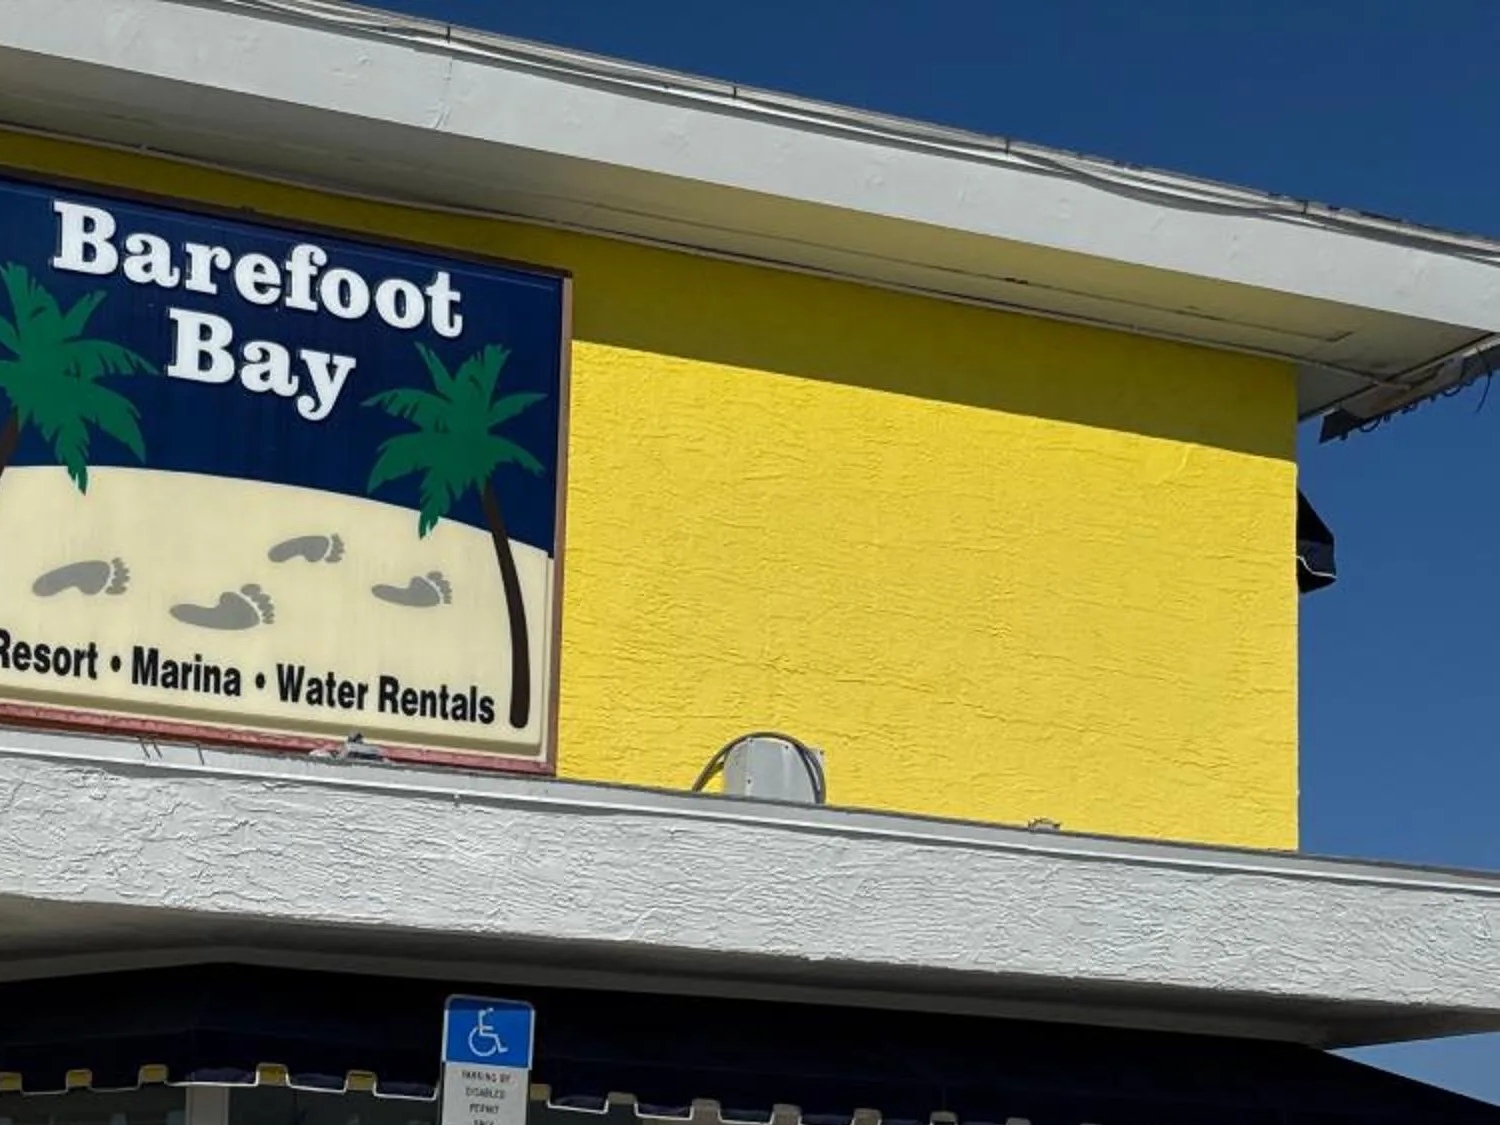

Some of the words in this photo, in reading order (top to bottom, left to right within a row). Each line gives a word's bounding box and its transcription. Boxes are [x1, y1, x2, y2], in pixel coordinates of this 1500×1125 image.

[51, 199, 464, 340] Barefoot
[166, 307, 357, 421] Bay
[130, 645, 242, 698] Marina
[276, 662, 369, 712] Water
[378, 675, 495, 726] Rentals
[465, 1086, 506, 1099] DISABLED
[469, 1103, 500, 1114] PERMIT
